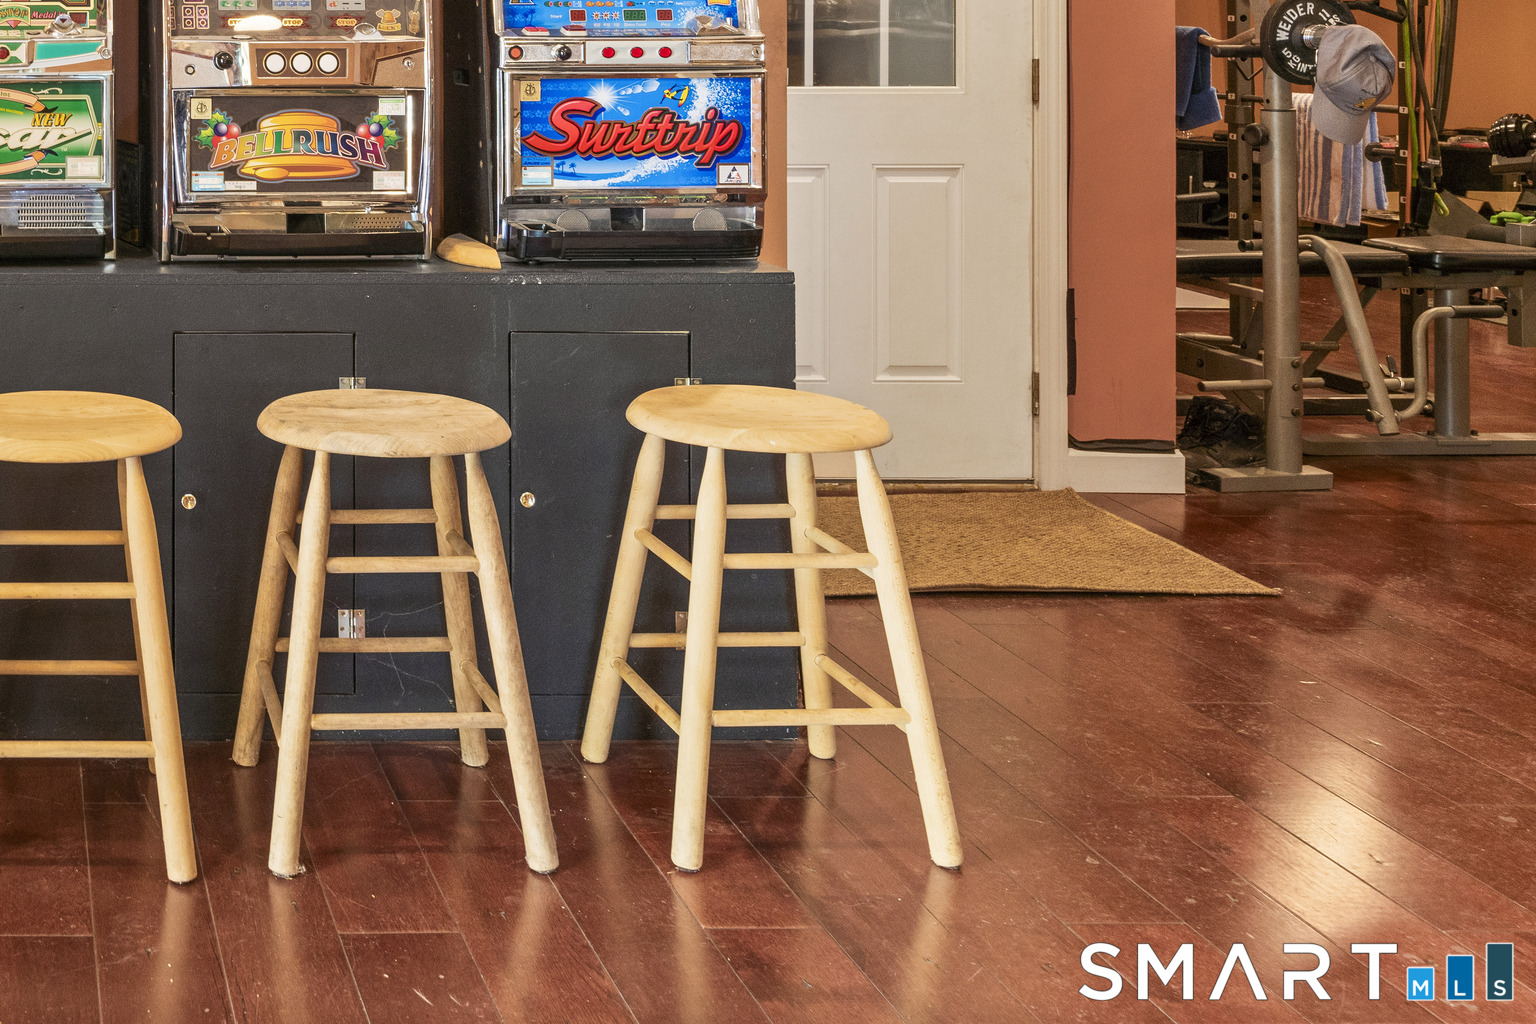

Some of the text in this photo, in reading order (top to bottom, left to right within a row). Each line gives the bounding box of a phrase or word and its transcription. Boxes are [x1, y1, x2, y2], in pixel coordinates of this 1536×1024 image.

[0, 7, 29, 19] STOP
[31, 11, 56, 19] Medal
[1275, 2, 1315, 42] WEIDER
[1281, 47, 1293, 59] 5
[1287, 54, 1301, 69] KG
[31, 112, 73, 127] NEW
[523, 98, 741, 167] Surftrip
[210, 129, 387, 169] BELLRUSH
